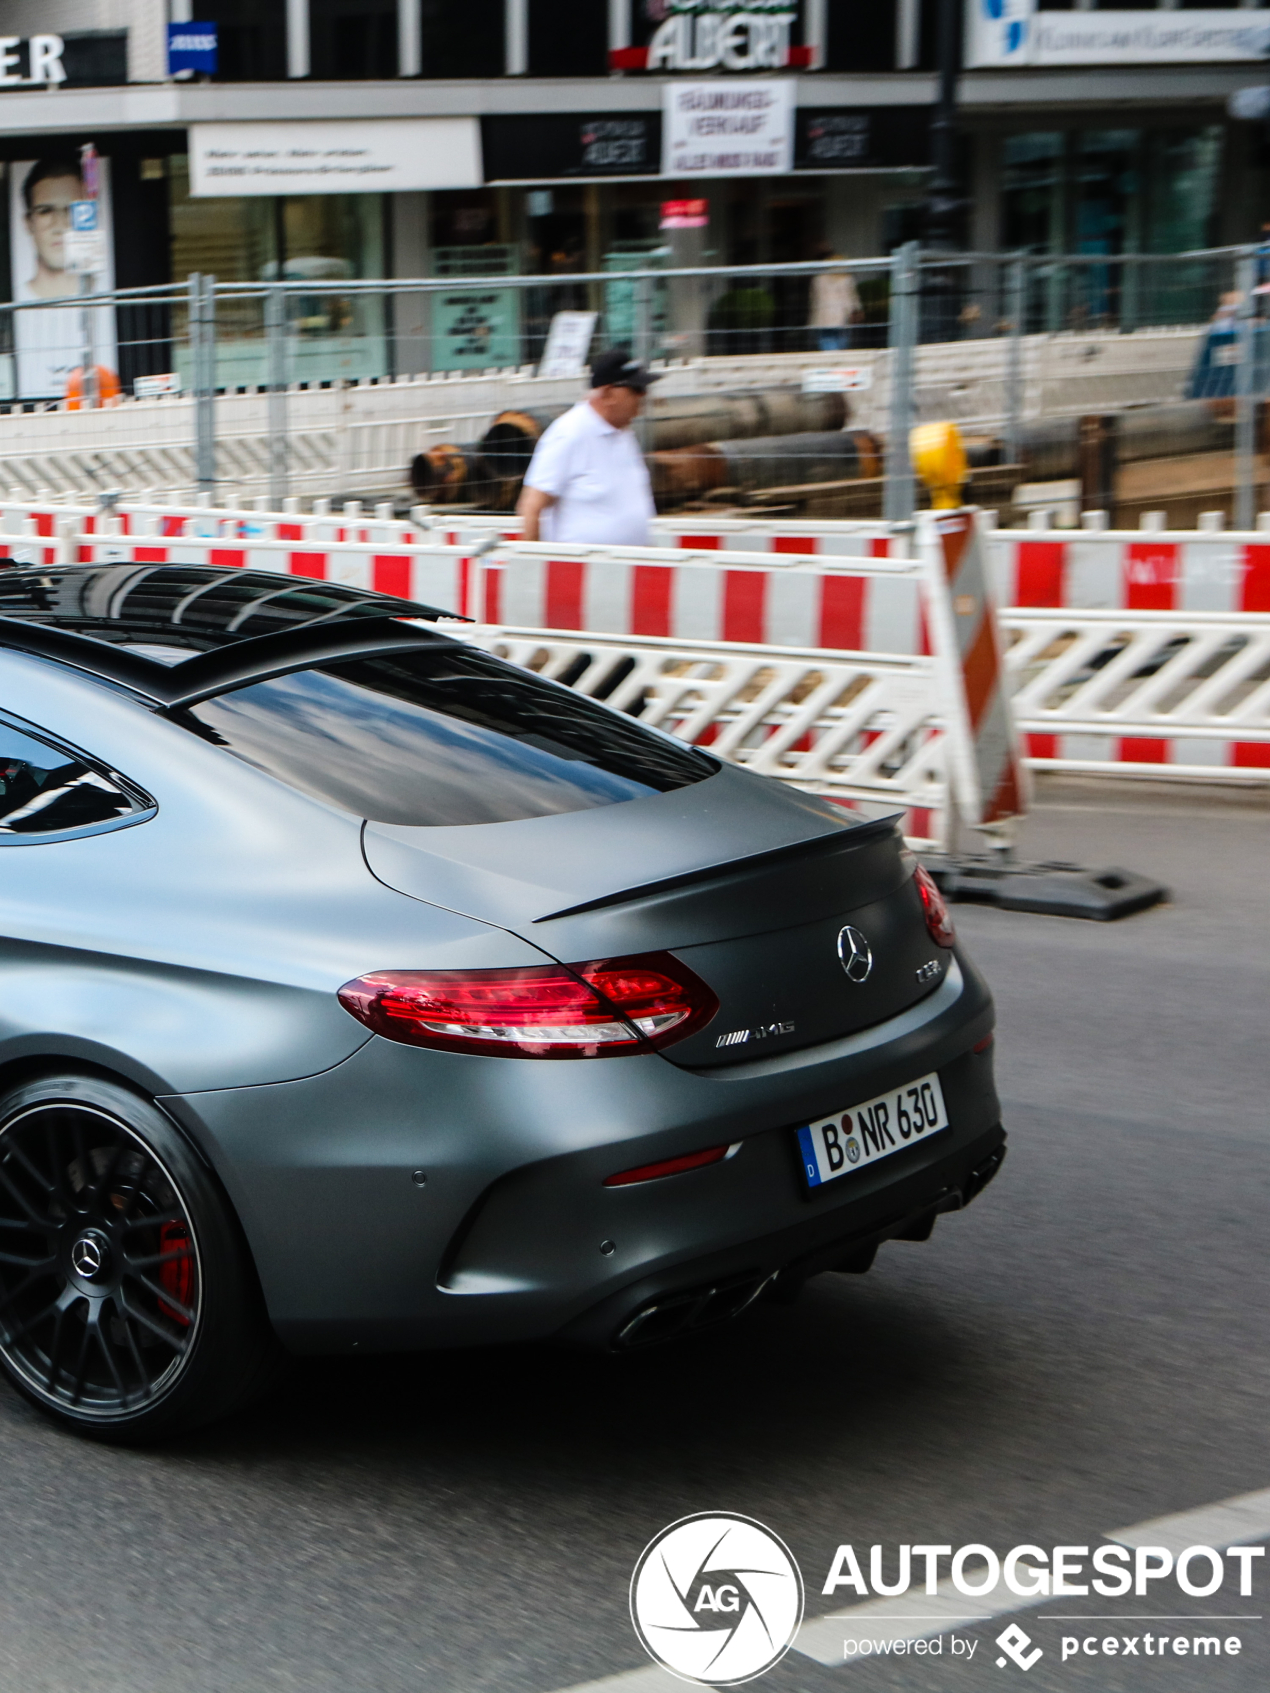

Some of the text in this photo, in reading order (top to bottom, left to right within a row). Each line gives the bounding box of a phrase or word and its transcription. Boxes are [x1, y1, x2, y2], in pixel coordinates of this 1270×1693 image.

[822, 1082, 938, 1172] B NR 630
[807, 1164, 815, 1178] D
